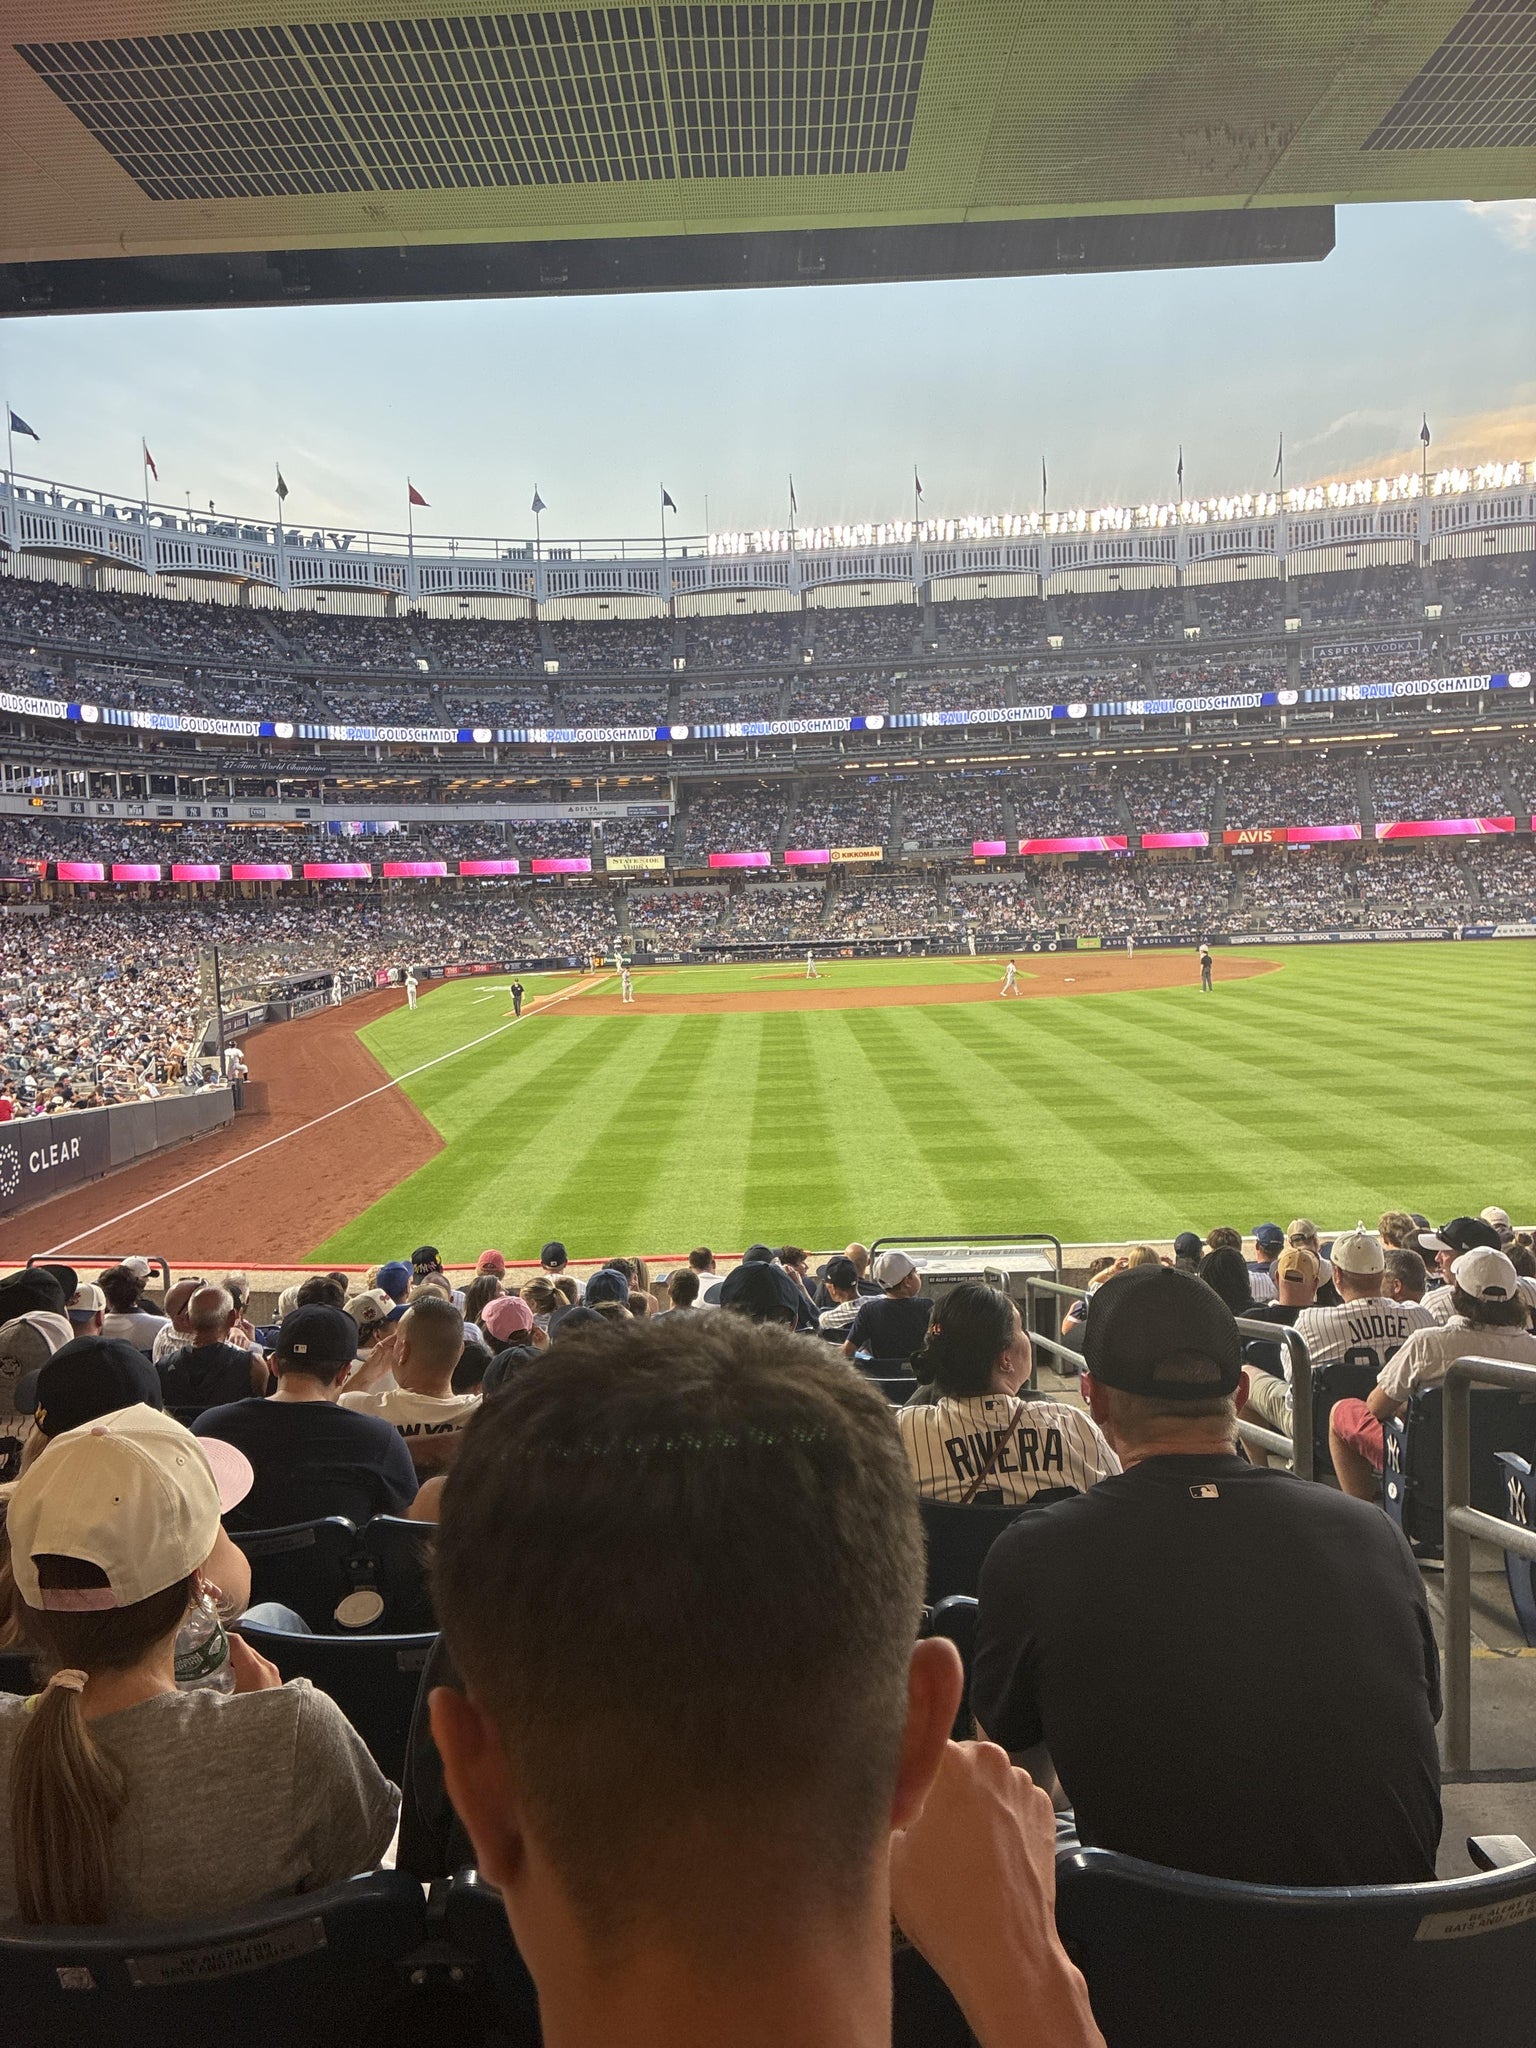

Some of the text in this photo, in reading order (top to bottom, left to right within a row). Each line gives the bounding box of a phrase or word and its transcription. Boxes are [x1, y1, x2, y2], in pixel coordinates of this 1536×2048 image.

[1468, 634, 1509, 644] ASPEN
[1319, 642, 1413, 657] ASPEN VODKA
[1395, 676, 1491, 695] GOLDSCHMIDT
[0, 693, 68, 719] OLDSCHMIDT
[1176, 694, 1262, 711] GOLDSCHMIDT
[970, 706, 1053, 723] GOLDSCHMIDT
[181, 717, 260, 736] GOLDSCHMIDT
[576, 727, 656, 741] GOLDSCHMIDT
[771, 718, 852, 734] GOLDSCHMIDT
[378, 728, 458, 742] GOLDSCHMIDT
[222, 760, 327, 774] 27-Time World Champions
[1238, 830, 1273, 844] AVIS
[613, 855, 659, 864] STATESIDE
[842, 851, 880, 859] KIKKOMAN
[29, 1137, 80, 1173] CLEAR
[1348, 1315, 1408, 1344] JUDGE
[945, 1428, 1063, 1481] RIVERA
[1488, 1901, 1522, 1917] ALERT
